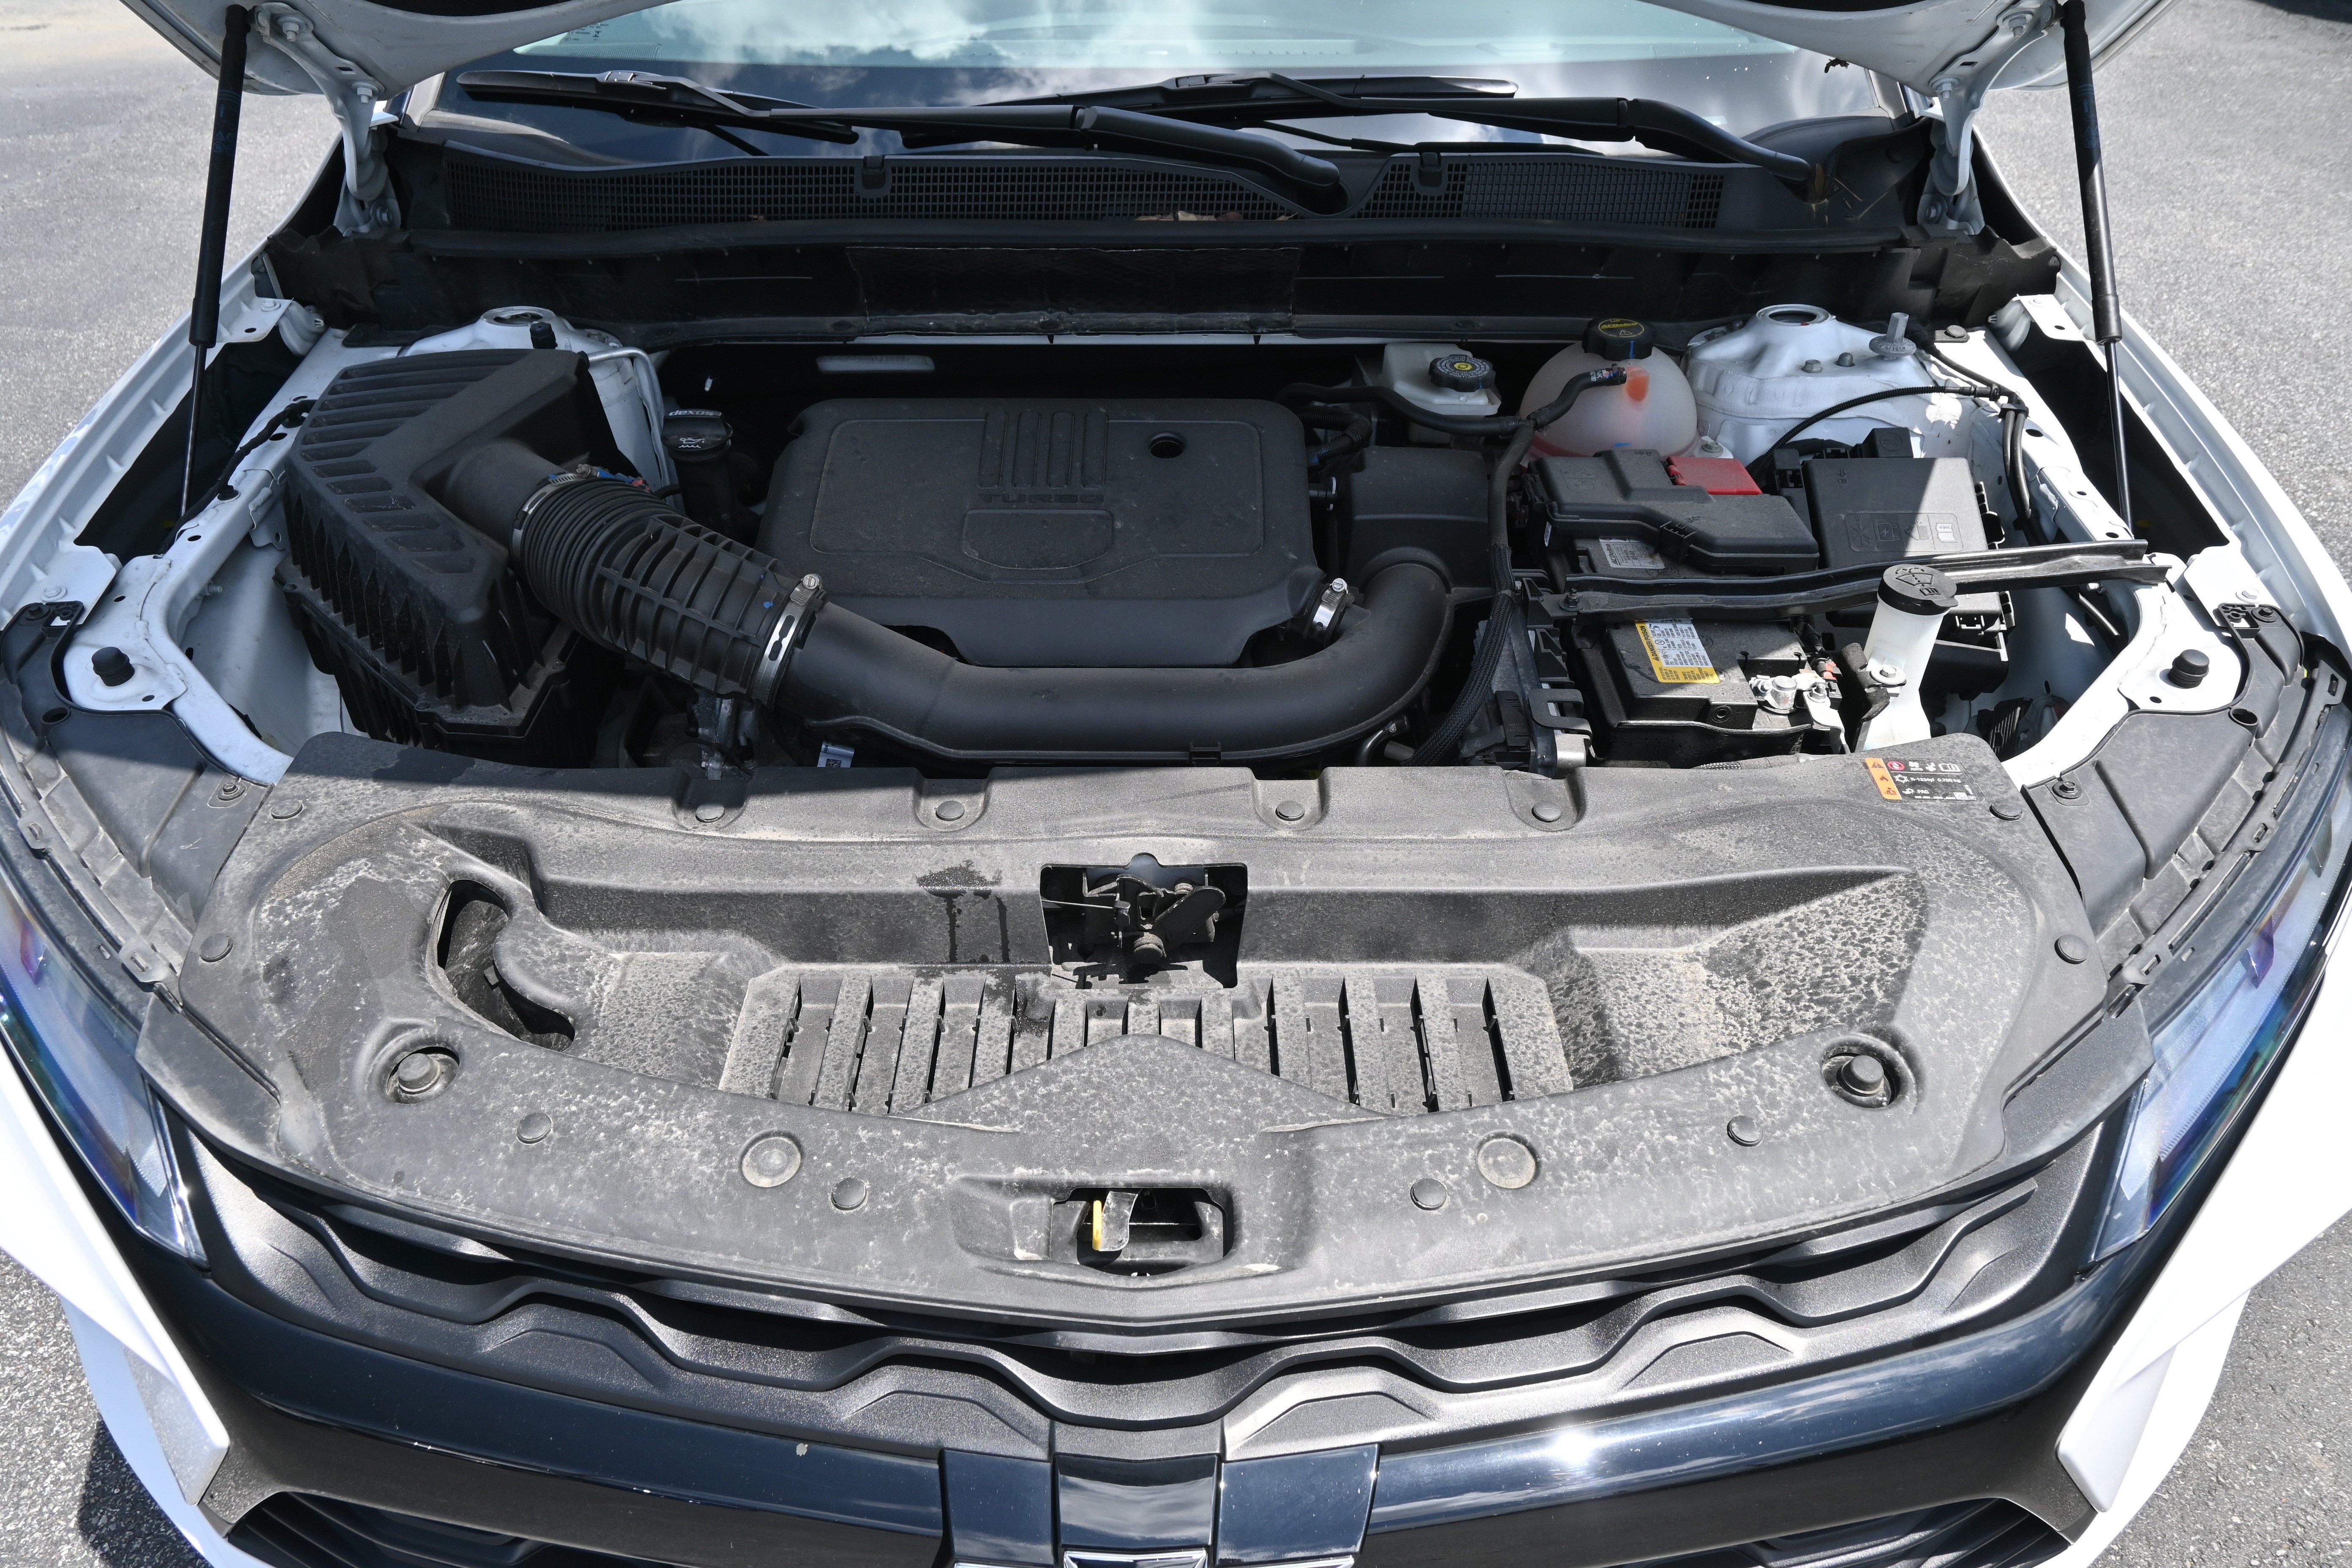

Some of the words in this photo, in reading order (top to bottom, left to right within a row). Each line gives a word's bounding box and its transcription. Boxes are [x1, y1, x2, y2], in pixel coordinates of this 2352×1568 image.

[976, 493, 1104, 502] TURBO
[1606, 543, 1618, 565] ACDelco
[1639, 626, 1657, 658] DANGER/POISON
